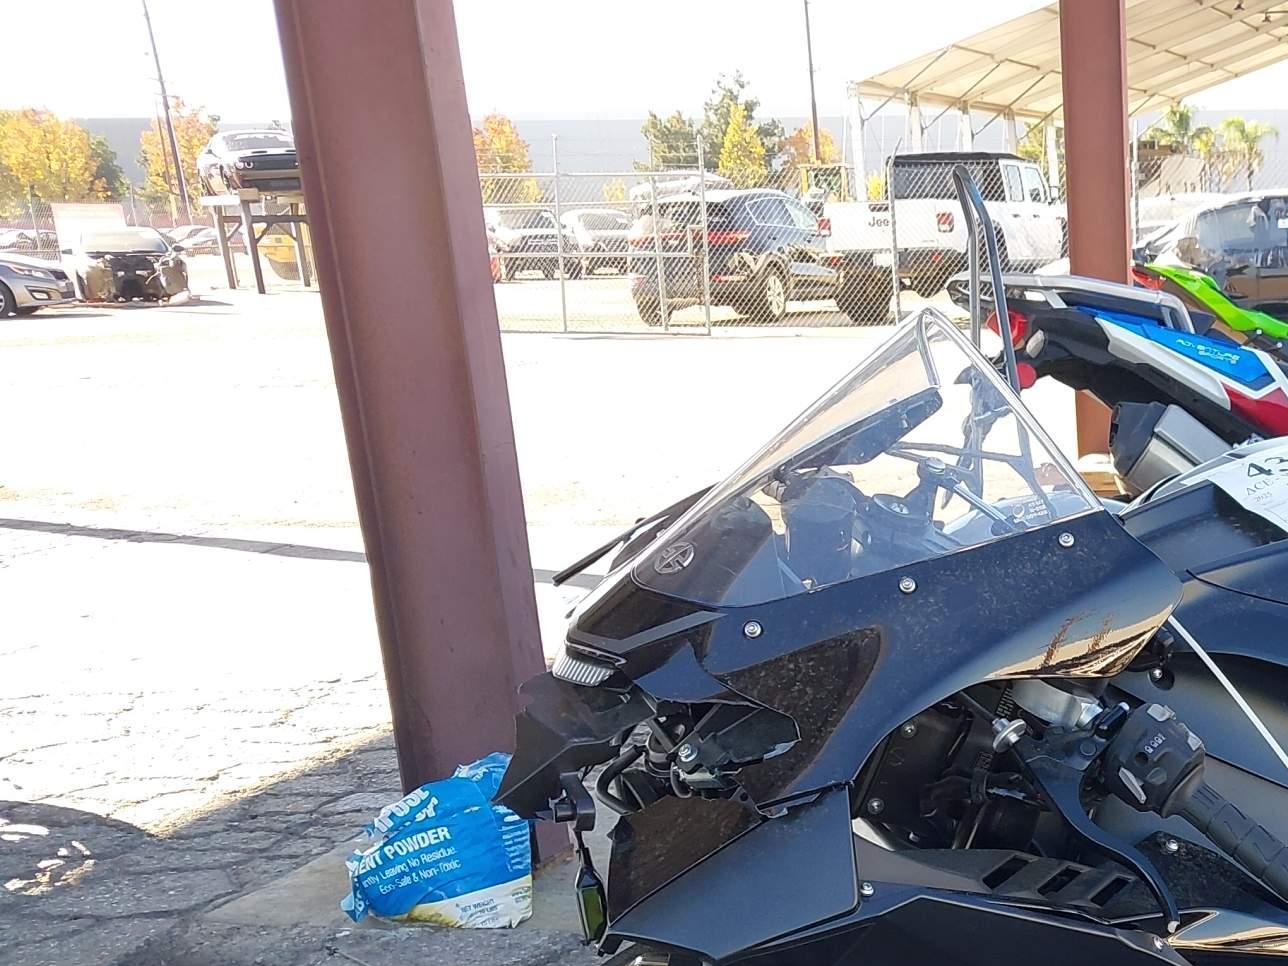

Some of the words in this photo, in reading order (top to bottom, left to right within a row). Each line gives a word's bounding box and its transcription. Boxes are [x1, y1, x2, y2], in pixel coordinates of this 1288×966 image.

[868, 216, 890, 227] Jee
[383, 826, 451, 860] POWDER
[378, 875, 413, 895] Eco-Safe
[412, 873, 419, 882] &
[418, 858, 462, 880] Non-Toxic
[379, 863, 410, 880] Leaving
[407, 856, 420, 868] No
